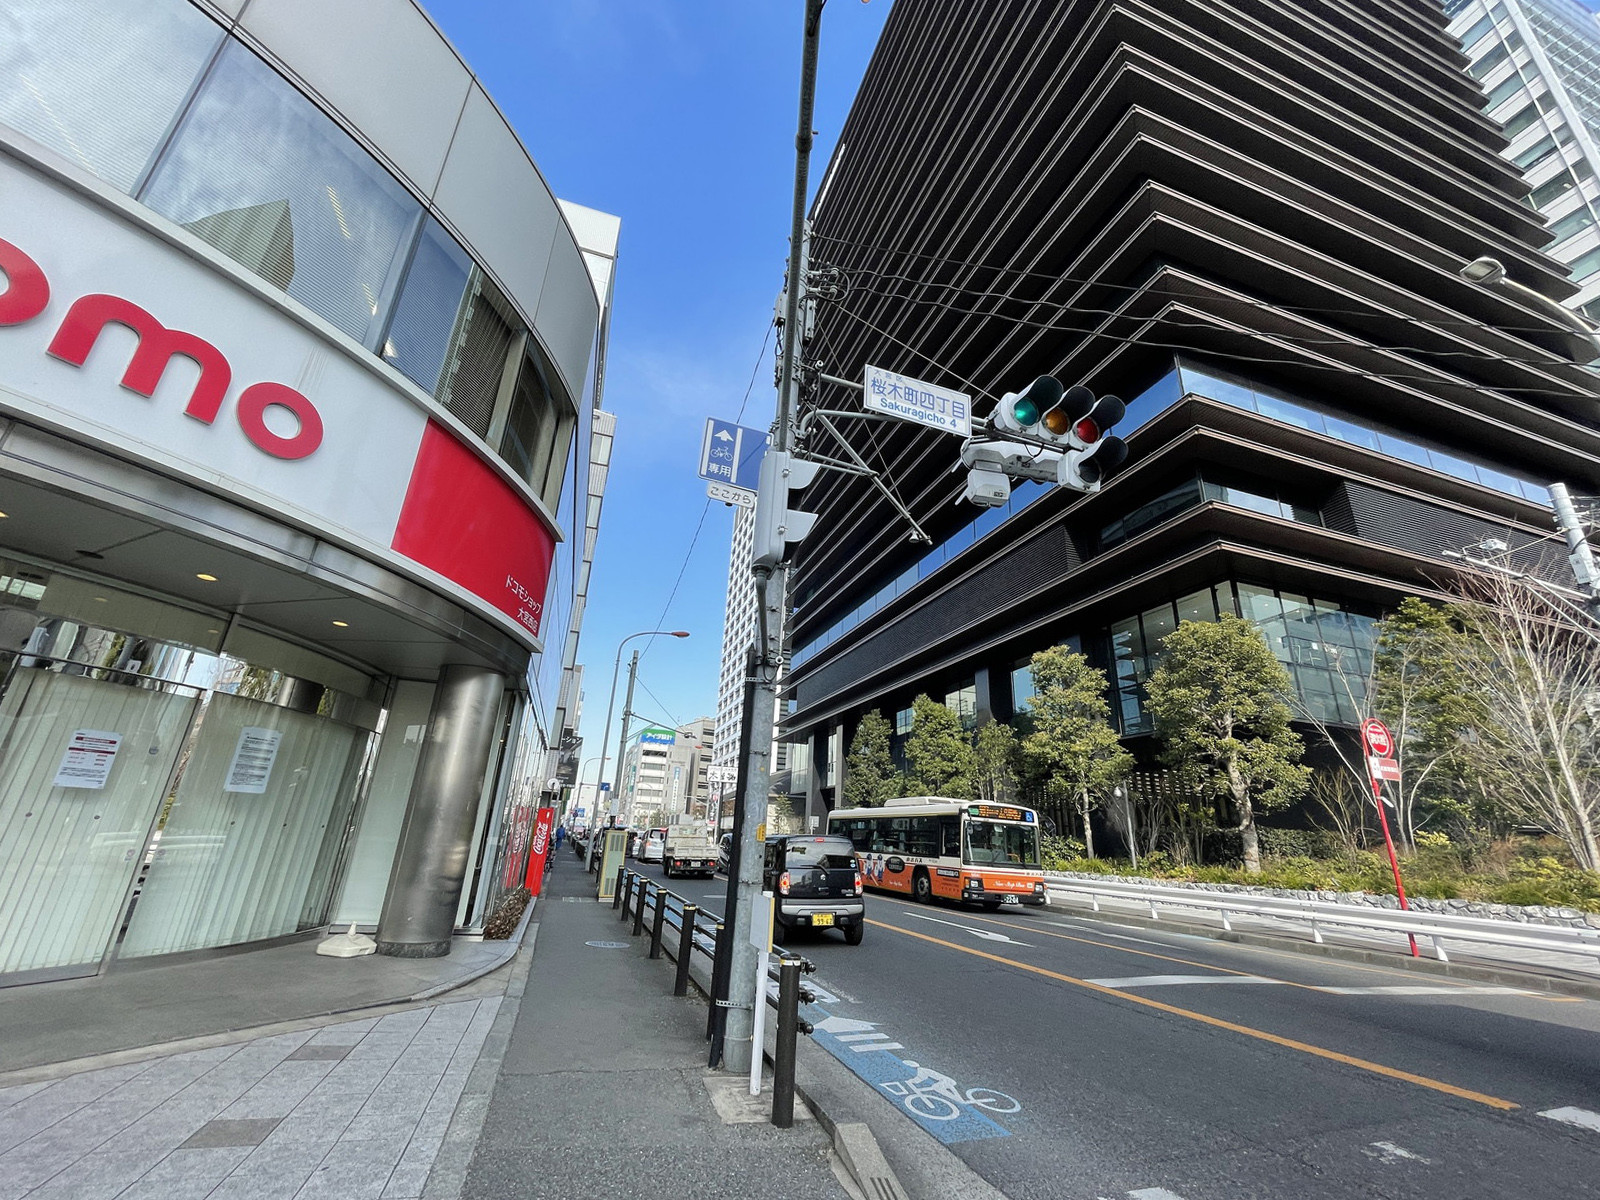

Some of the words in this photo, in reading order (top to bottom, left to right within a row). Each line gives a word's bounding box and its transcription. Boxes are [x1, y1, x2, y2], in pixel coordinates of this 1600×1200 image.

[871, 377, 965, 419] 桜木町四丁目
[880, 398, 946, 424] Sakuragicho
[949, 419, 957, 428] 4
[707, 462, 732, 477] 専用
[710, 486, 752, 504] ここから
[505, 574, 541, 614] ドコモショップ
